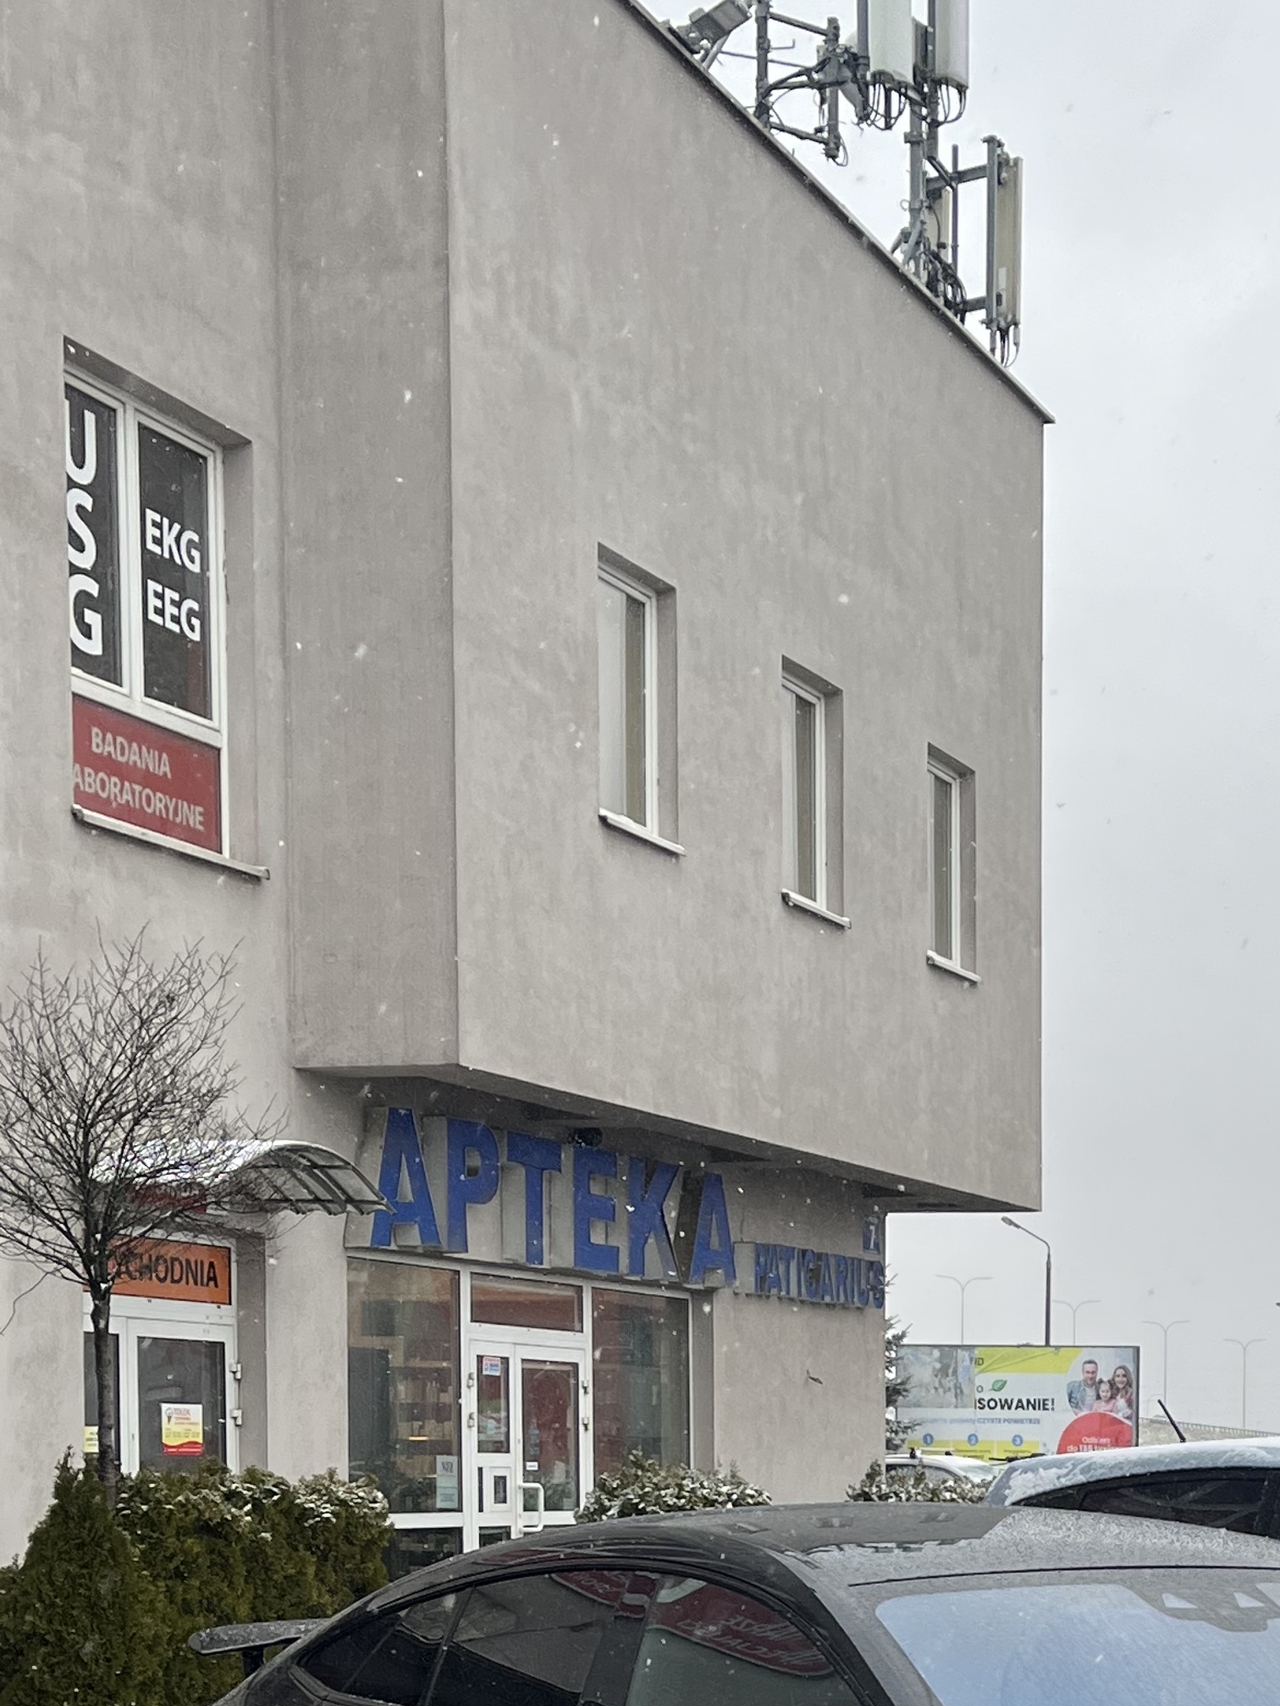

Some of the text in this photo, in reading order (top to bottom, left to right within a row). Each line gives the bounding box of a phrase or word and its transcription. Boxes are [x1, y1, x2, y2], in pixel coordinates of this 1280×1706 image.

[145, 507, 201, 574] EKG
[147, 578, 201, 642] EEG
[91, 726, 171, 779] BADANIA
[369, 1106, 738, 1288] APTEKA
